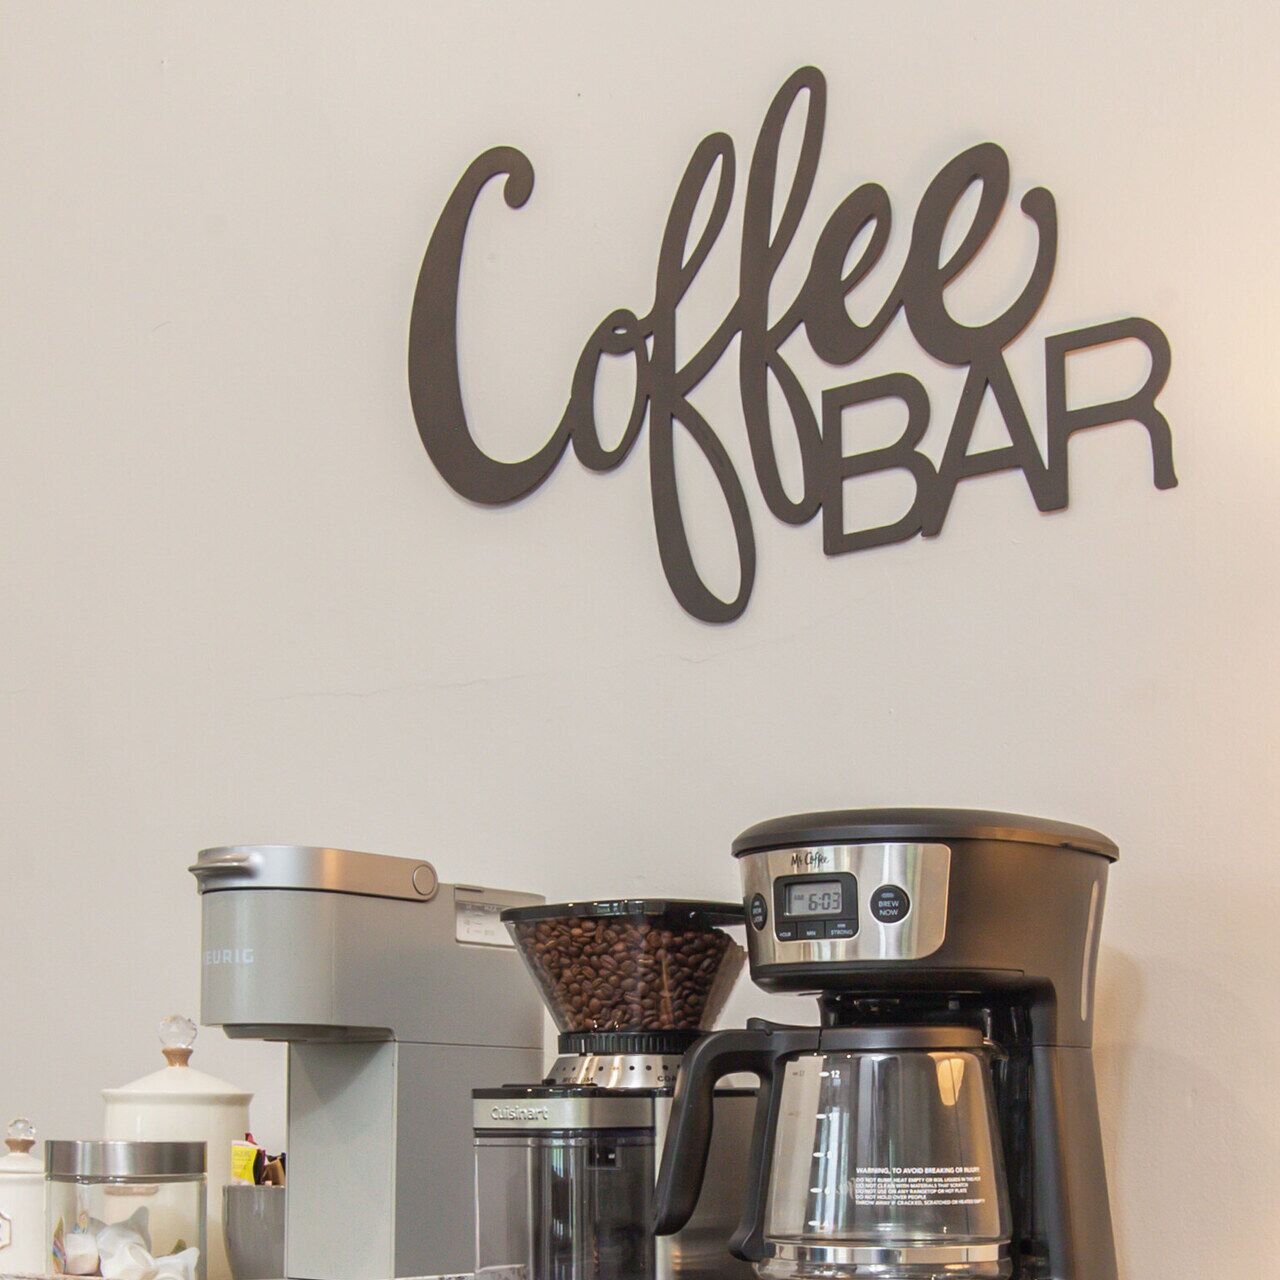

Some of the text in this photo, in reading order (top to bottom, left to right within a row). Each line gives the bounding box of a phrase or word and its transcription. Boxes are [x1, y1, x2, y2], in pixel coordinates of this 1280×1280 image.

[407, 65, 1058, 623] Coffee
[821, 317, 1179, 555] BAR
[808, 892, 840, 911] 6:03
[205, 949, 254, 964] EURIG
[830, 1070, 840, 1078] 12
[491, 1105, 548, 1120] Cuisinart
